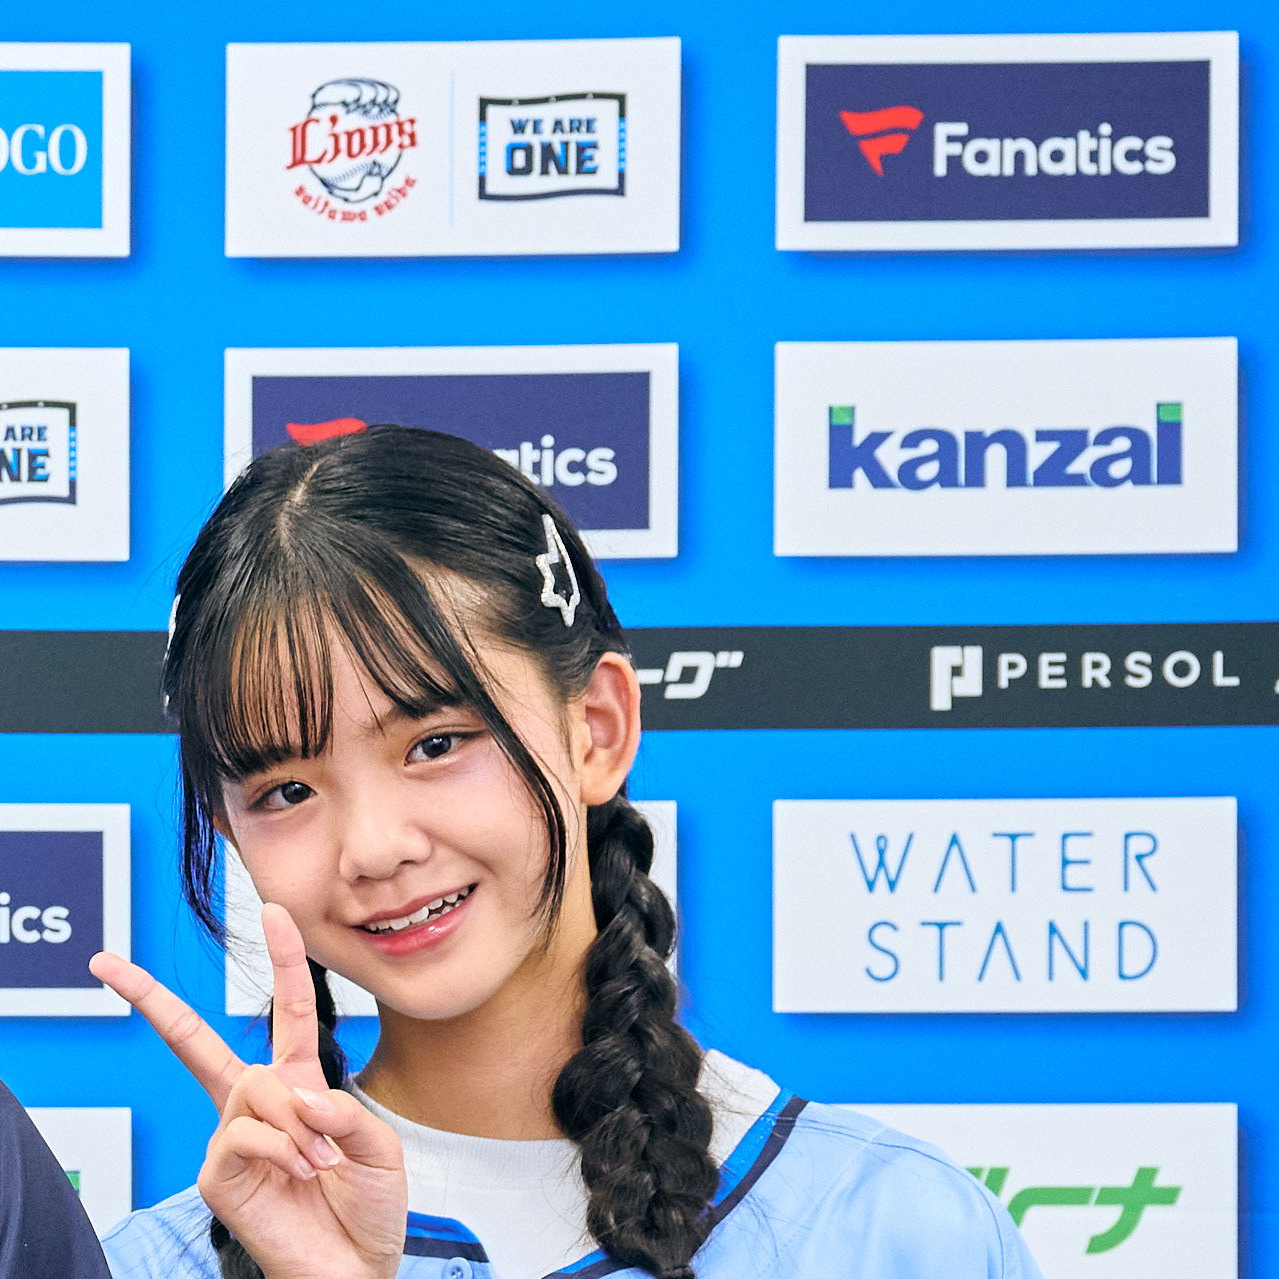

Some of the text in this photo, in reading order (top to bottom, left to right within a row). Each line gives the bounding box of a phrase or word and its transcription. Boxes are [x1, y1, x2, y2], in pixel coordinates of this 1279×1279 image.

[288, 115, 416, 169] Lions
[510, 116, 596, 136] WE ARE
[933, 122, 1176, 177] Fanatics
[505, 139, 599, 178] ONE
[3, 425, 48, 442] ARE
[828, 402, 1183, 491] kanzai
[998, 651, 1240, 689] PERSOL
[851, 832, 1157, 893] WATER
[866, 921, 1157, 982] STAND
